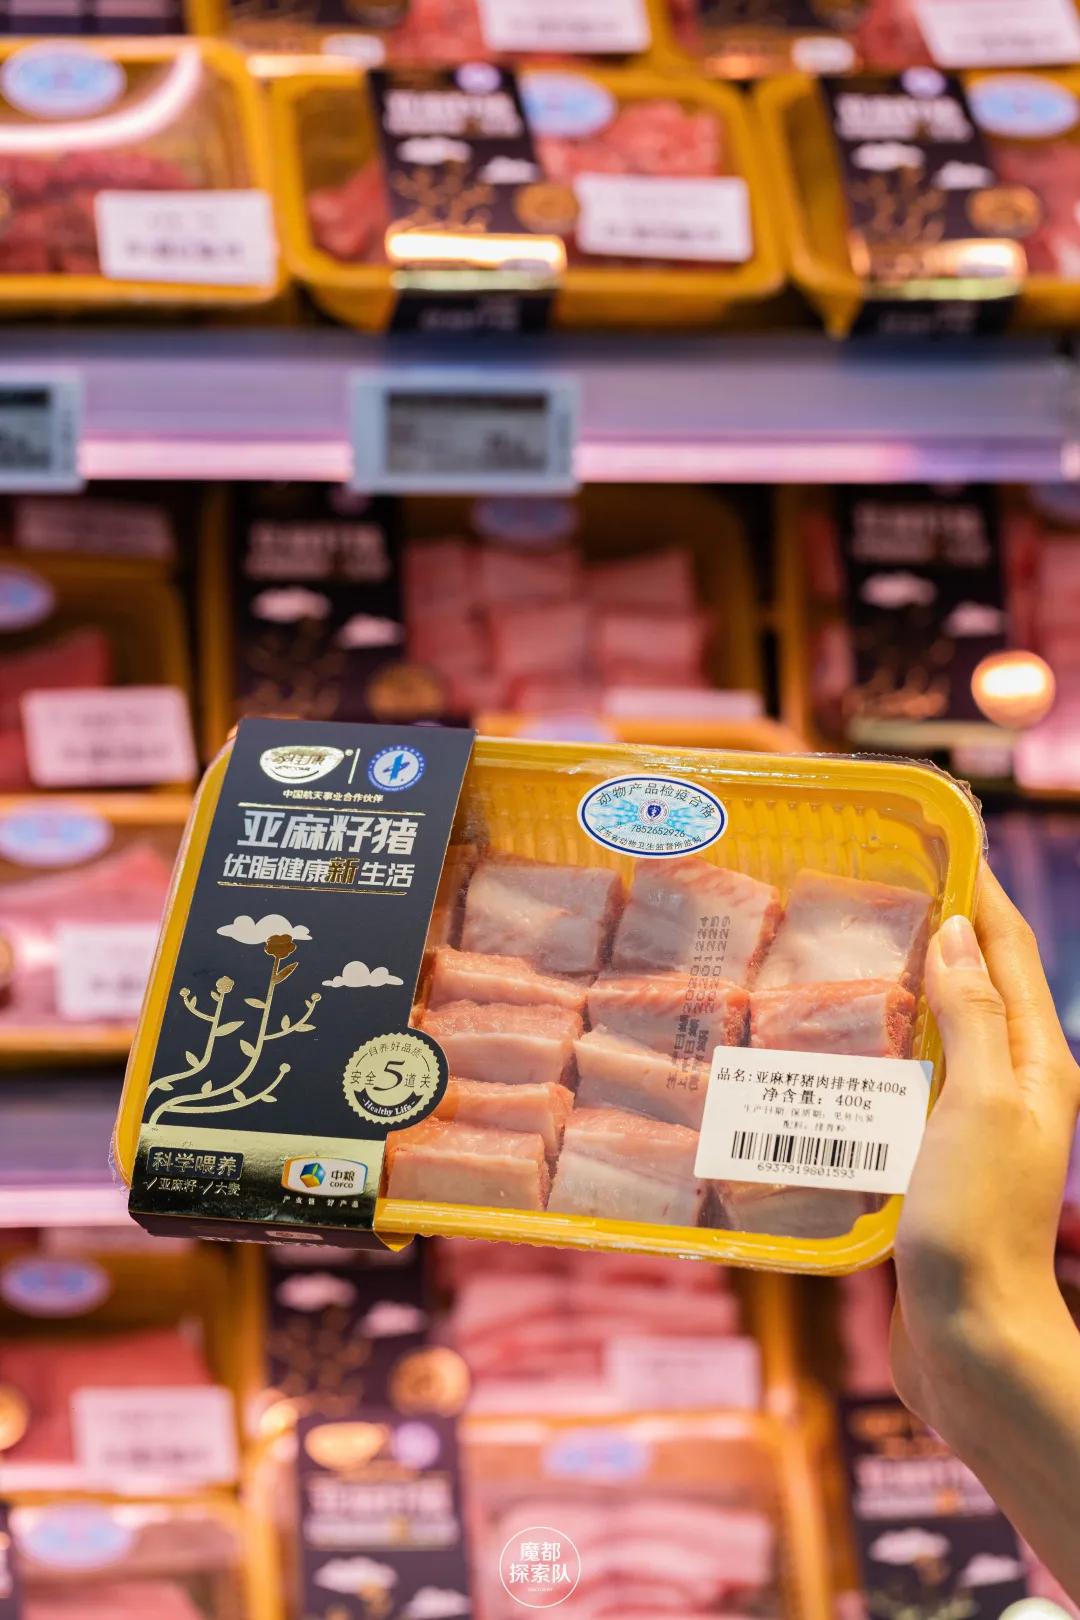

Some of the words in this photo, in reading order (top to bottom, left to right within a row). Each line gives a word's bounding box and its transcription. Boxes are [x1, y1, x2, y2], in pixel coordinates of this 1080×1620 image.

[282, 789, 385, 804] 中国航天事业合作伙伴
[595, 783, 717, 818] 动物产品检疫合格
[236, 810, 419, 856] 亚麻籽猪
[222, 853, 416, 888] 优脂健康新生活
[152, 1150, 238, 1177] 科学喂养
[158, 1178, 198, 1193] 亚麻籽
[329, 1181, 354, 1190] COFCO
[331, 1168, 356, 1183] 中粮
